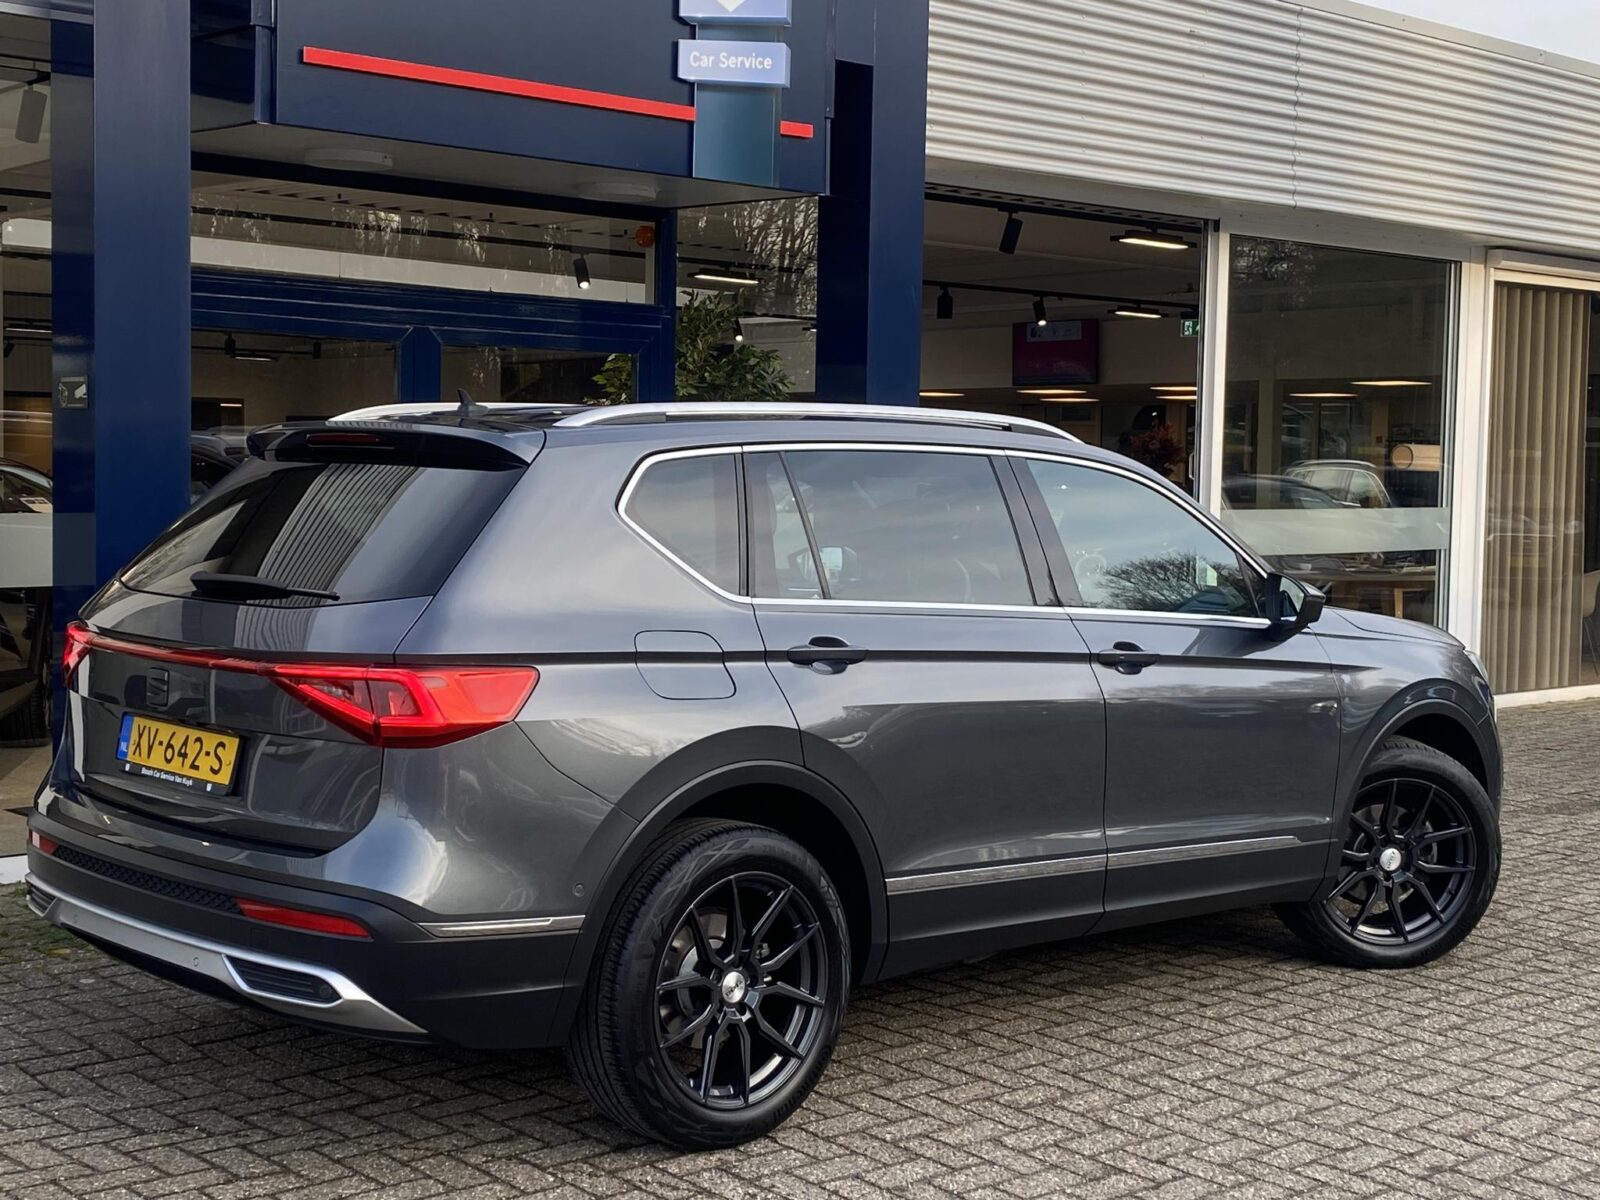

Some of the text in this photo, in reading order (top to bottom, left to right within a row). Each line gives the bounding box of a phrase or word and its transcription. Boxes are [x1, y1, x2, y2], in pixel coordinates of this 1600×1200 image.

[689, 51, 772, 69] Car Service
[120, 741, 128, 752] NL
[132, 724, 226, 775] XV-642-S
[153, 770, 161, 778] Car
[160, 772, 175, 782] Service
